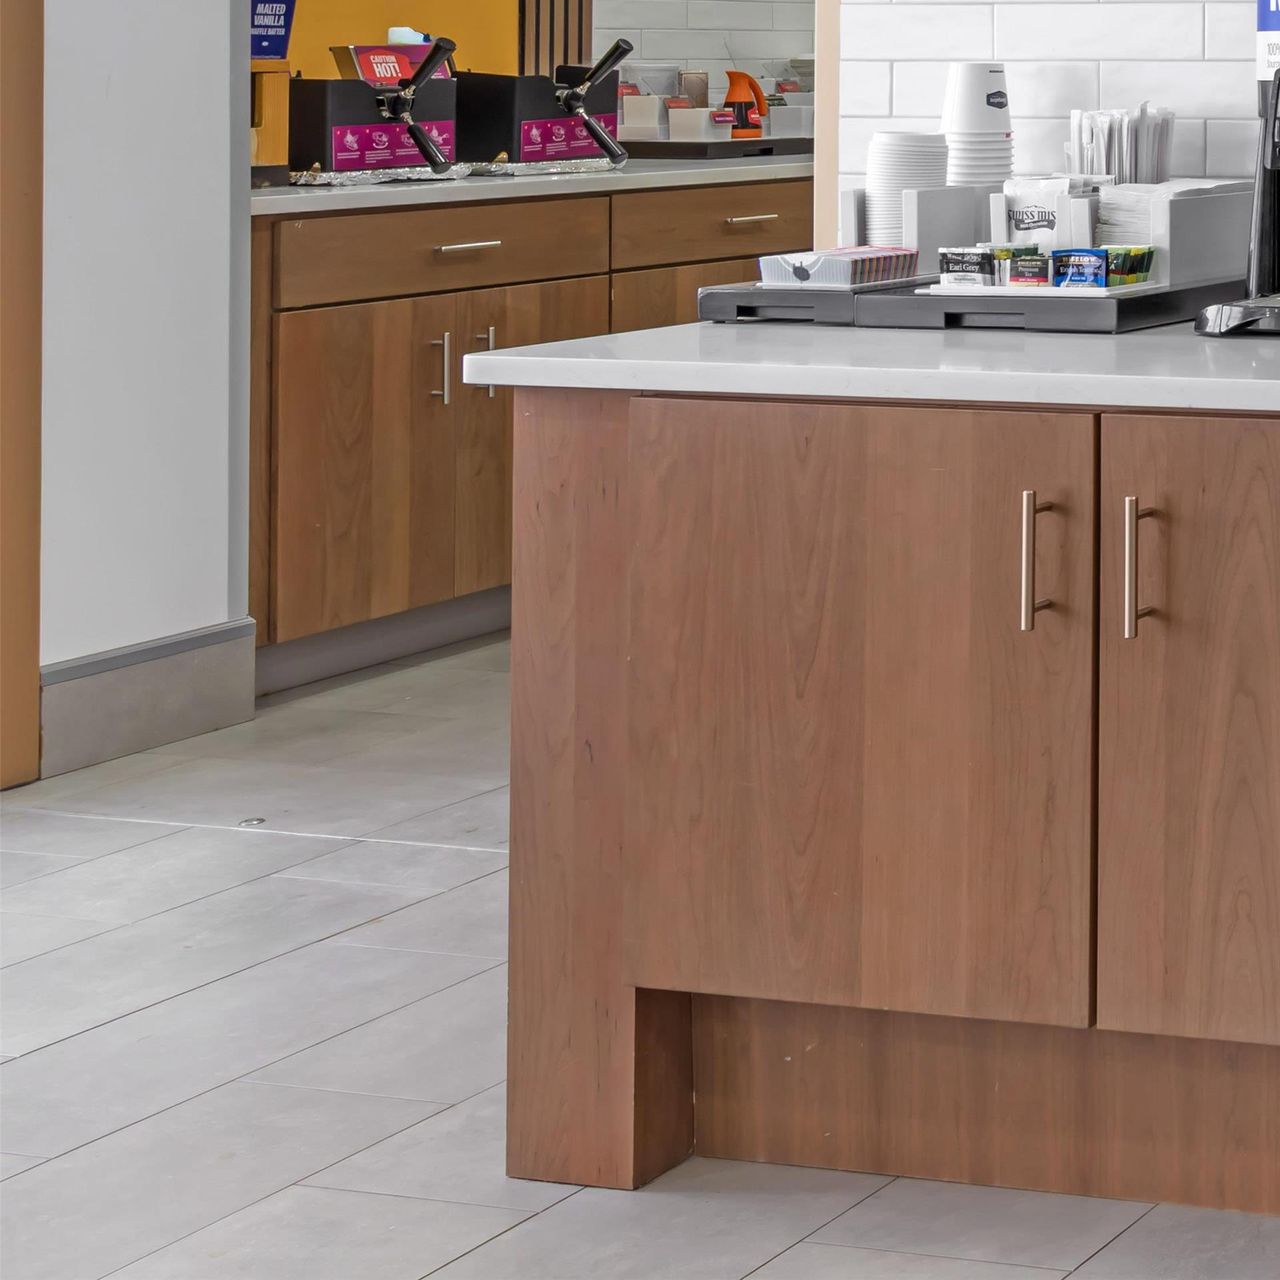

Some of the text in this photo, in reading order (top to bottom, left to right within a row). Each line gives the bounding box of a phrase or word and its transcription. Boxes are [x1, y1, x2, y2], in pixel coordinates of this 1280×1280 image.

[256, 3, 286, 15] MALTED
[254, 15, 285, 26] VANILLA
[370, 55, 397, 63] CAUTION
[373, 63, 402, 78] HOT!
[949, 263, 980, 273] Earl Grey
